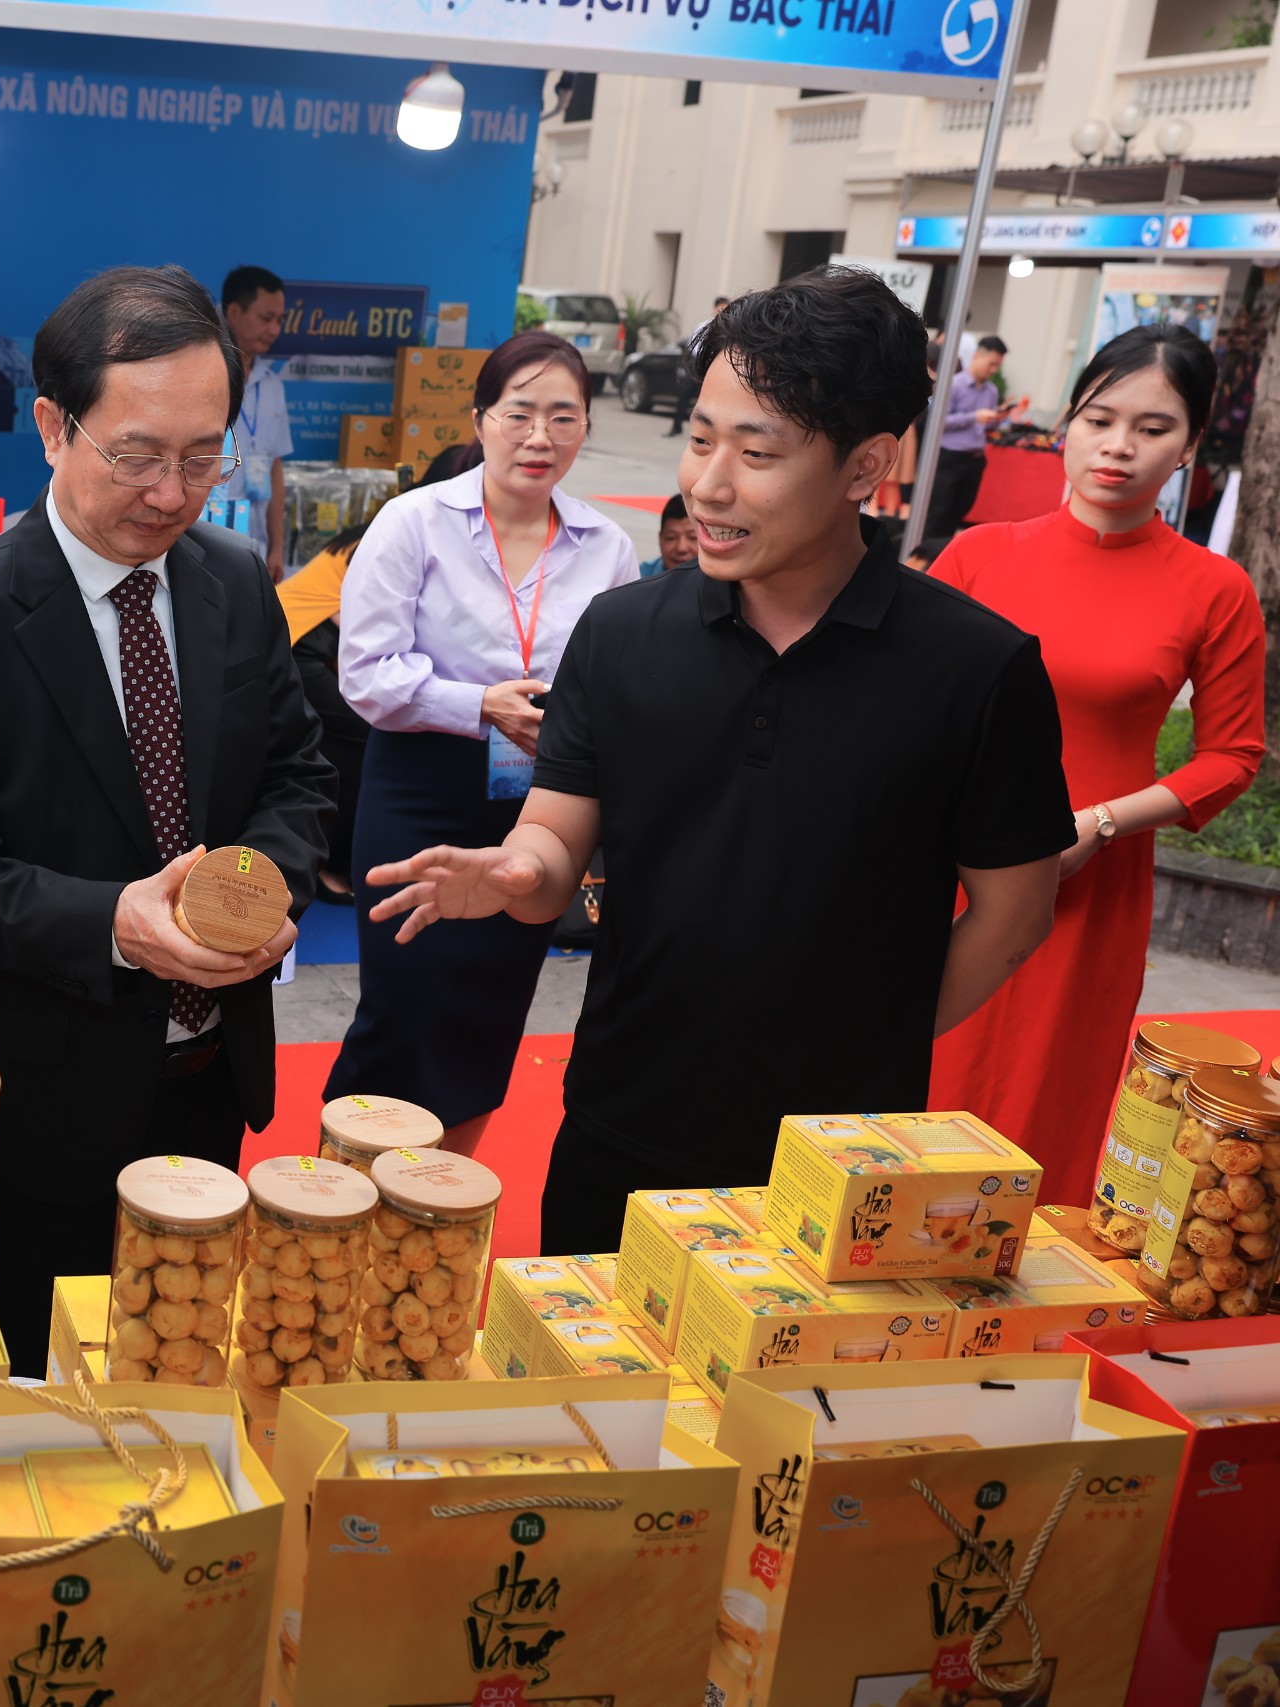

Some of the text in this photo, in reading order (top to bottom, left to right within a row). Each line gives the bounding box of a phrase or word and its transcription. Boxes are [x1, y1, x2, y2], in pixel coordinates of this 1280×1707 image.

[46, 76, 128, 119] NÔNG
[136, 85, 243, 131] NGHIỆP
[251, 90, 285, 131] VÀ
[294, 98, 358, 139] DỊCH
[470, 105, 527, 144] THÁI
[366, 306, 414, 339] BTC
[854, 1186, 892, 1216] Hoa
[1119, 1200, 1152, 1217] OCOP
[850, 1215, 893, 1249] Vàng
[877, 1259, 899, 1267] Golden
[997, 1260, 1012, 1268] 30G
[762, 1326, 800, 1358] Hoa
[964, 1320, 1002, 1350] Hoa
[1085, 1474, 1157, 1496] OCOP
[516, 1519, 540, 1538] Trà
[634, 1508, 710, 1533] OCOP
[184, 1551, 258, 1586] OCOP
[58, 1580, 85, 1599] Trà
[469, 1550, 561, 1619] Hoa
[10, 1610, 108, 1679] Hoa
[464, 1616, 567, 1690] Vàng
[937, 1667, 971, 1680] HOA
[482, 1686, 521, 1701] QUY
